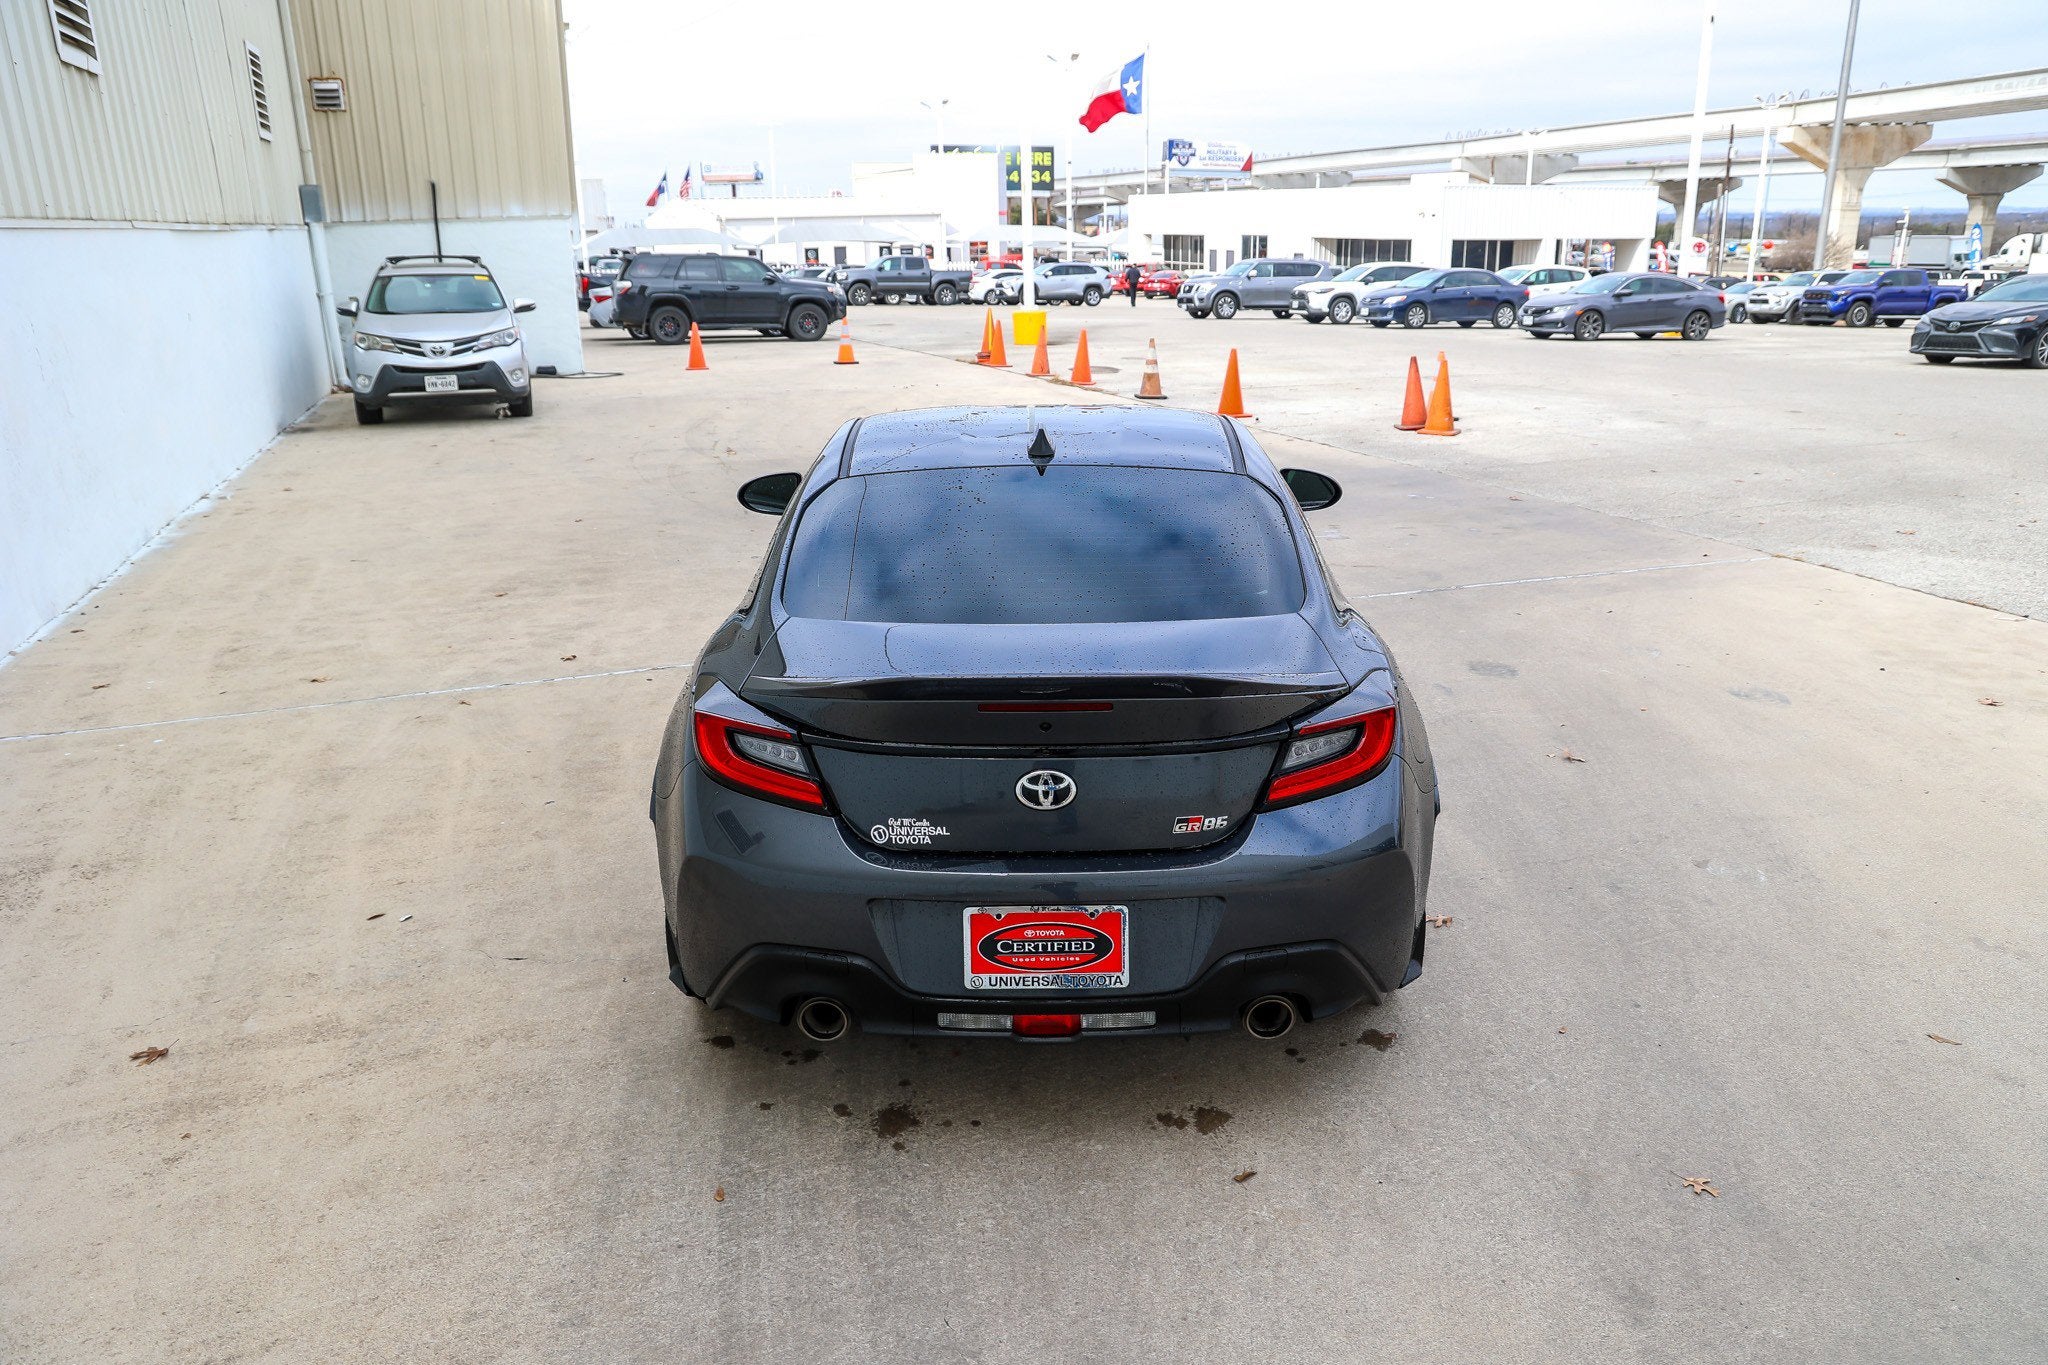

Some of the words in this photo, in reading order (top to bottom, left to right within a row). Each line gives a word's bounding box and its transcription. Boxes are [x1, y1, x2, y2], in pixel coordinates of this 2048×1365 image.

[1175, 823, 1201, 831] GR
[1203, 816, 1229, 831] 86
[889, 826, 951, 836] UNIVERSAL
[890, 835, 932, 845] TOYOTA
[996, 940, 1095, 954] CERTIFIED
[989, 976, 1066, 987] UNIVERSAL
[1069, 975, 1123, 986] TOYOTA
